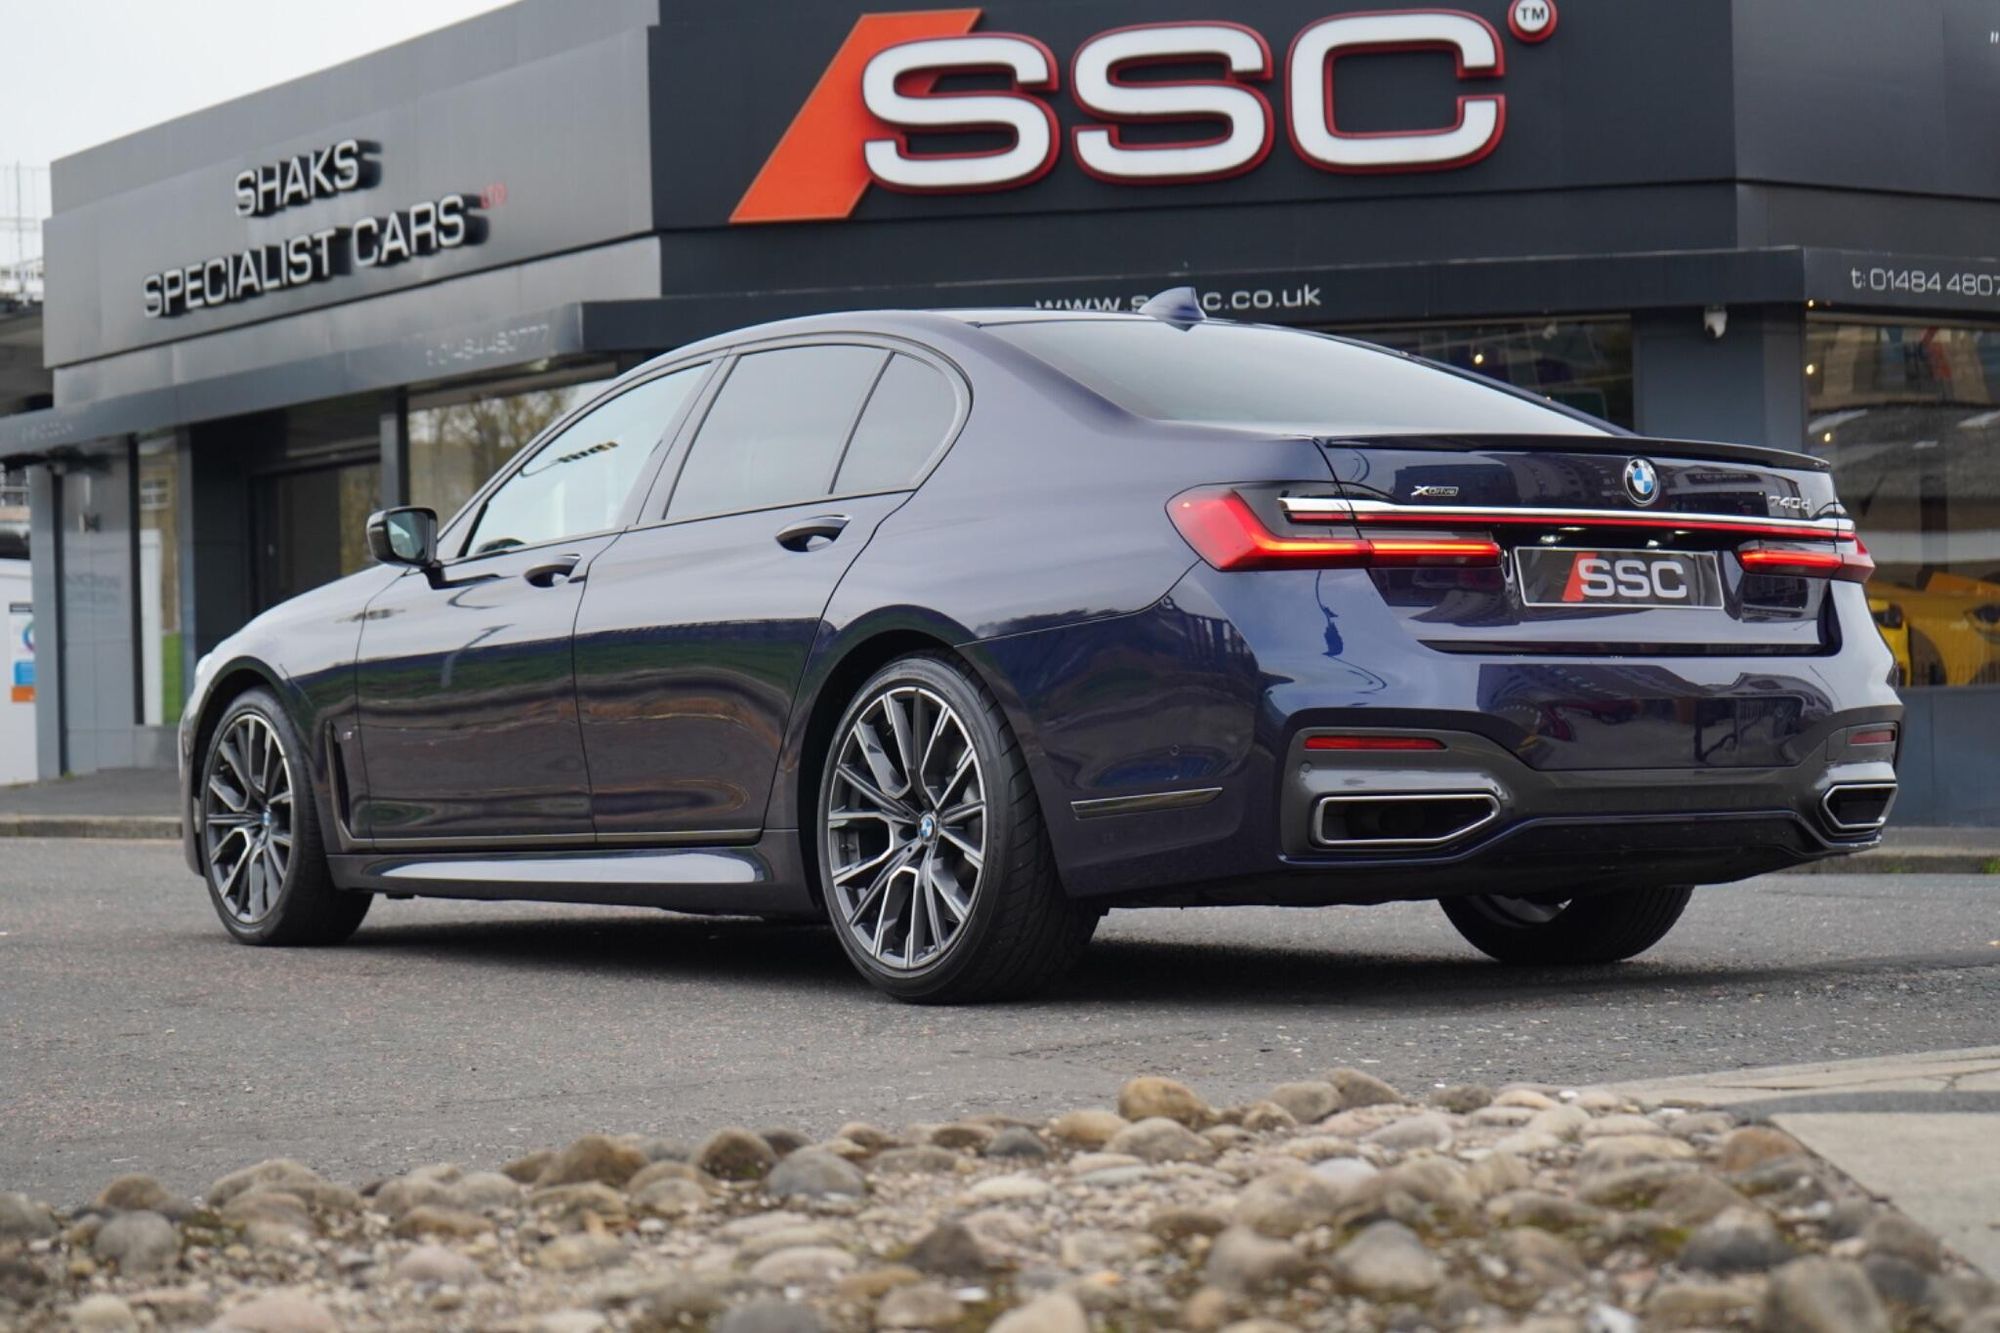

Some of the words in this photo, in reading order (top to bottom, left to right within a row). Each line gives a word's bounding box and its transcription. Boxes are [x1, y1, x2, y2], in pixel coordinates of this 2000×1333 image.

[1520, 7, 1545, 21] TM
[862, 9, 1505, 192] SSC
[234, 139, 359, 216] SHAKS
[143, 228, 336, 318] SPECIALIST
[352, 195, 465, 267] CARS
[1578, 558, 1687, 598] SSC
